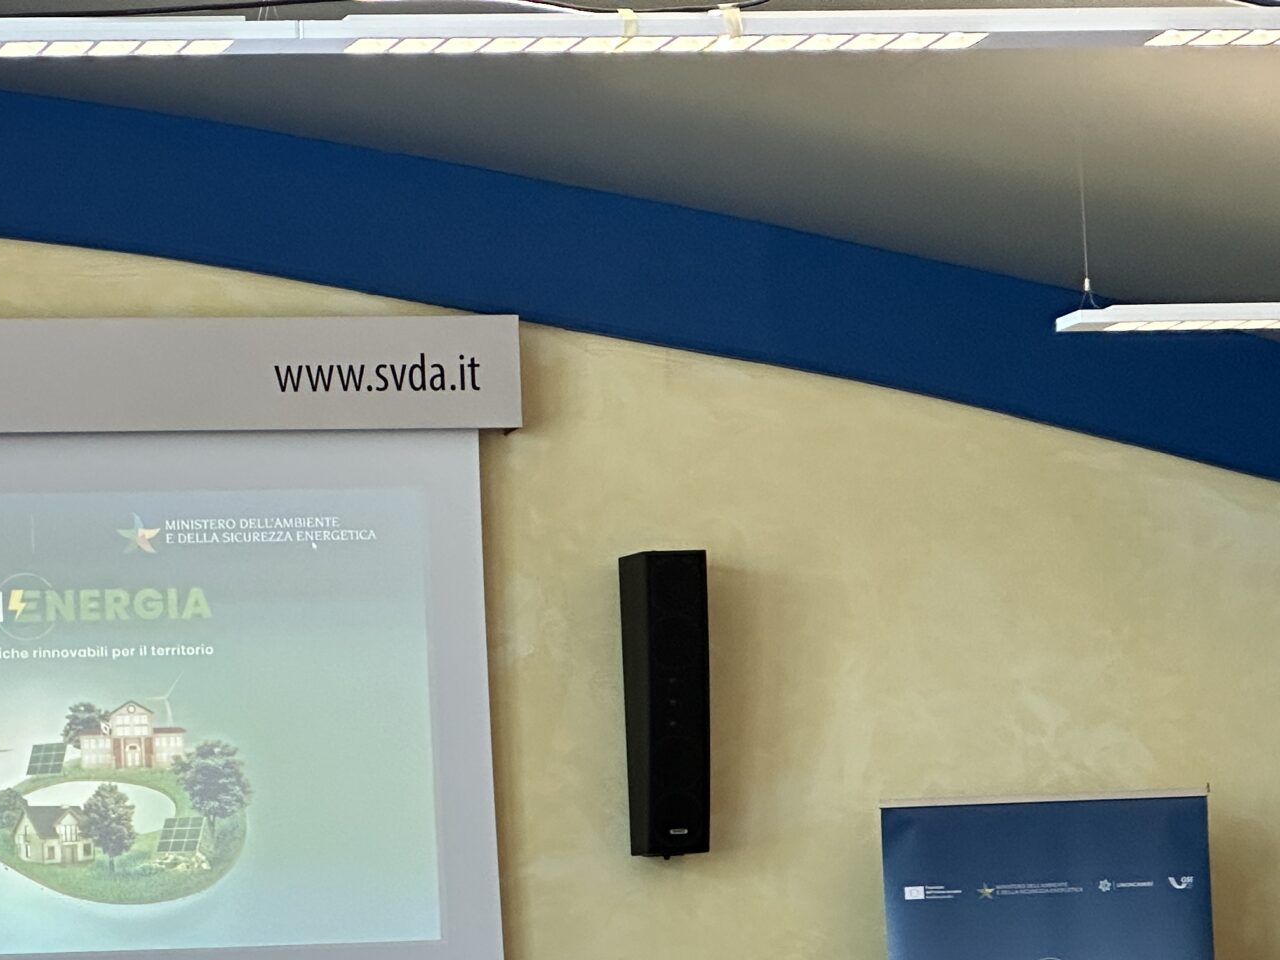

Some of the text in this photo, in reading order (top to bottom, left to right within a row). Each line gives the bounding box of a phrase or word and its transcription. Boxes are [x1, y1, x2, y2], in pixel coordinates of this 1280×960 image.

[274, 352, 481, 392] www.svda.it
[165, 516, 341, 531] MINISTERO DELL'AMBIENTE
[166, 529, 377, 544] E DELLA SICUREZZA ENERGETICA
[32, 645, 108, 660] rinnovabili
[112, 648, 135, 660] per
[139, 645, 147, 657] il
[151, 643, 214, 657] territorio
